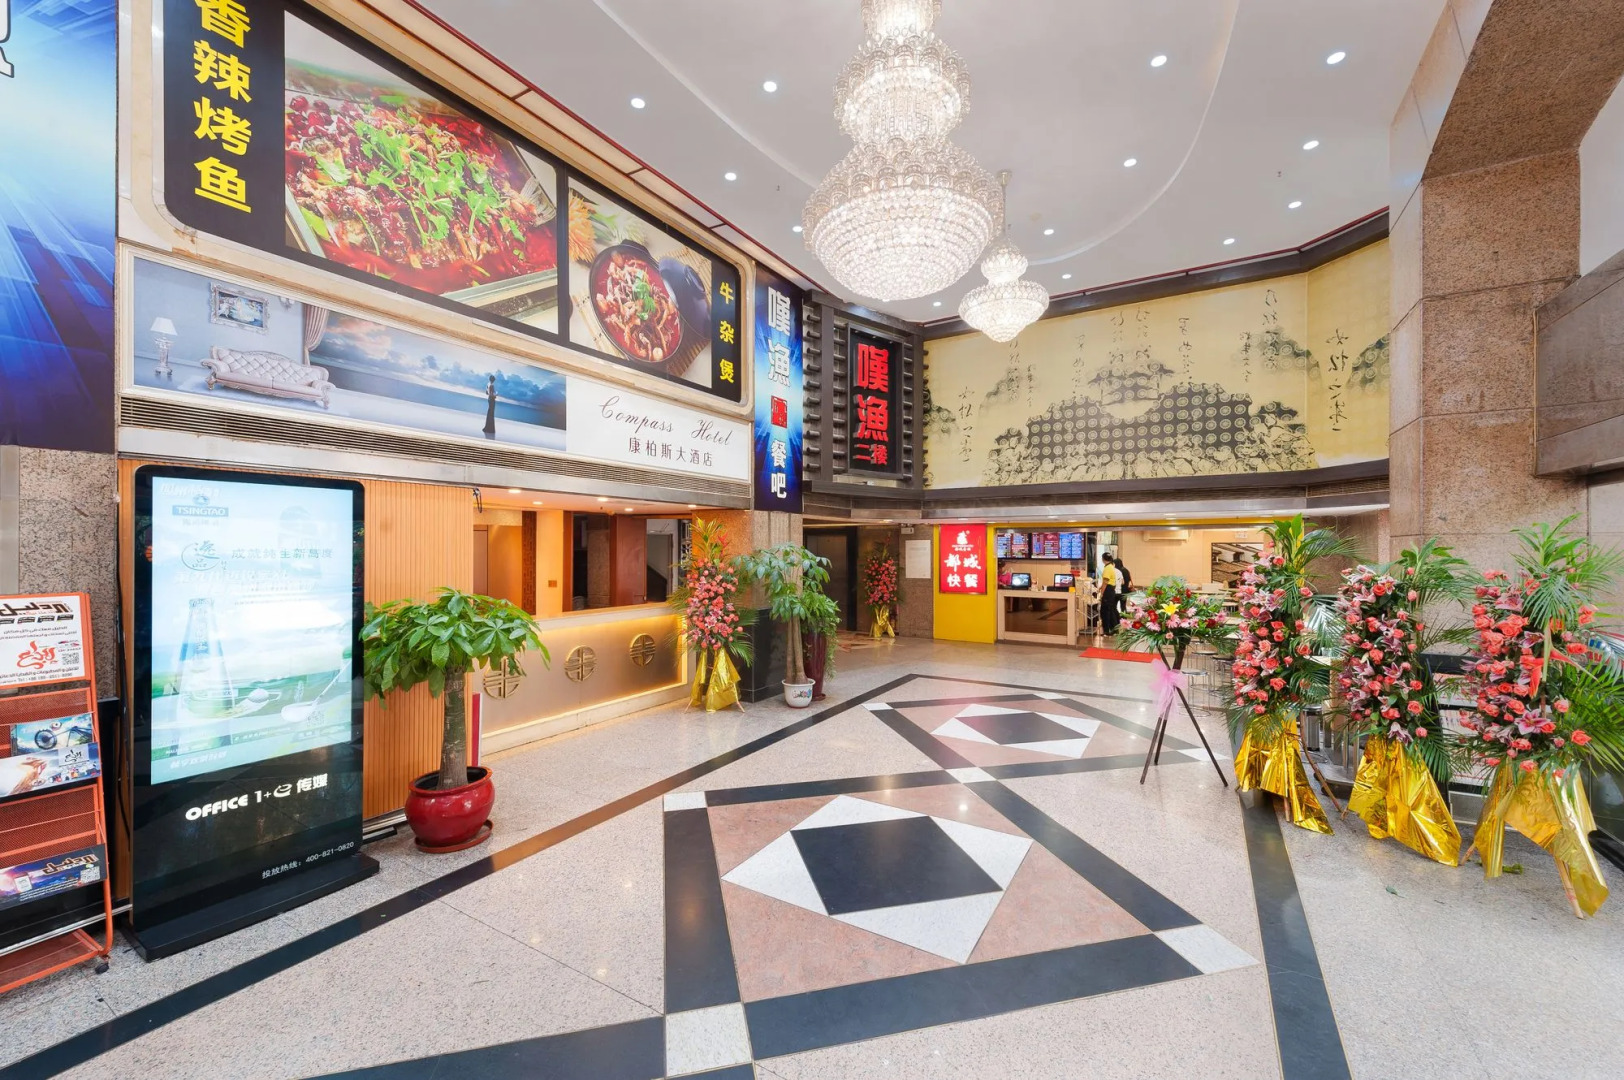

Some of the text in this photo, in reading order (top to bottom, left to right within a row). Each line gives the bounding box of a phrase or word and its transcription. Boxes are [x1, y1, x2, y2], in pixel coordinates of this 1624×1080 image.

[193, 0, 252, 213] 香辣烤鱼
[720, 282, 735, 384] 牛杂煲
[598, 395, 733, 446] Compass Hotel
[628, 437, 713, 467] 康柏斯大酒店
[770, 439, 787, 499] 餐吧
[175, 506, 226, 516] TSINGTAO
[944, 553, 981, 573] 都城
[946, 573, 979, 588] 快餐
[185, 794, 249, 821] OFFICE
[296, 773, 328, 793] 传媒
[305, 841, 355, 863] 400-821-0820
